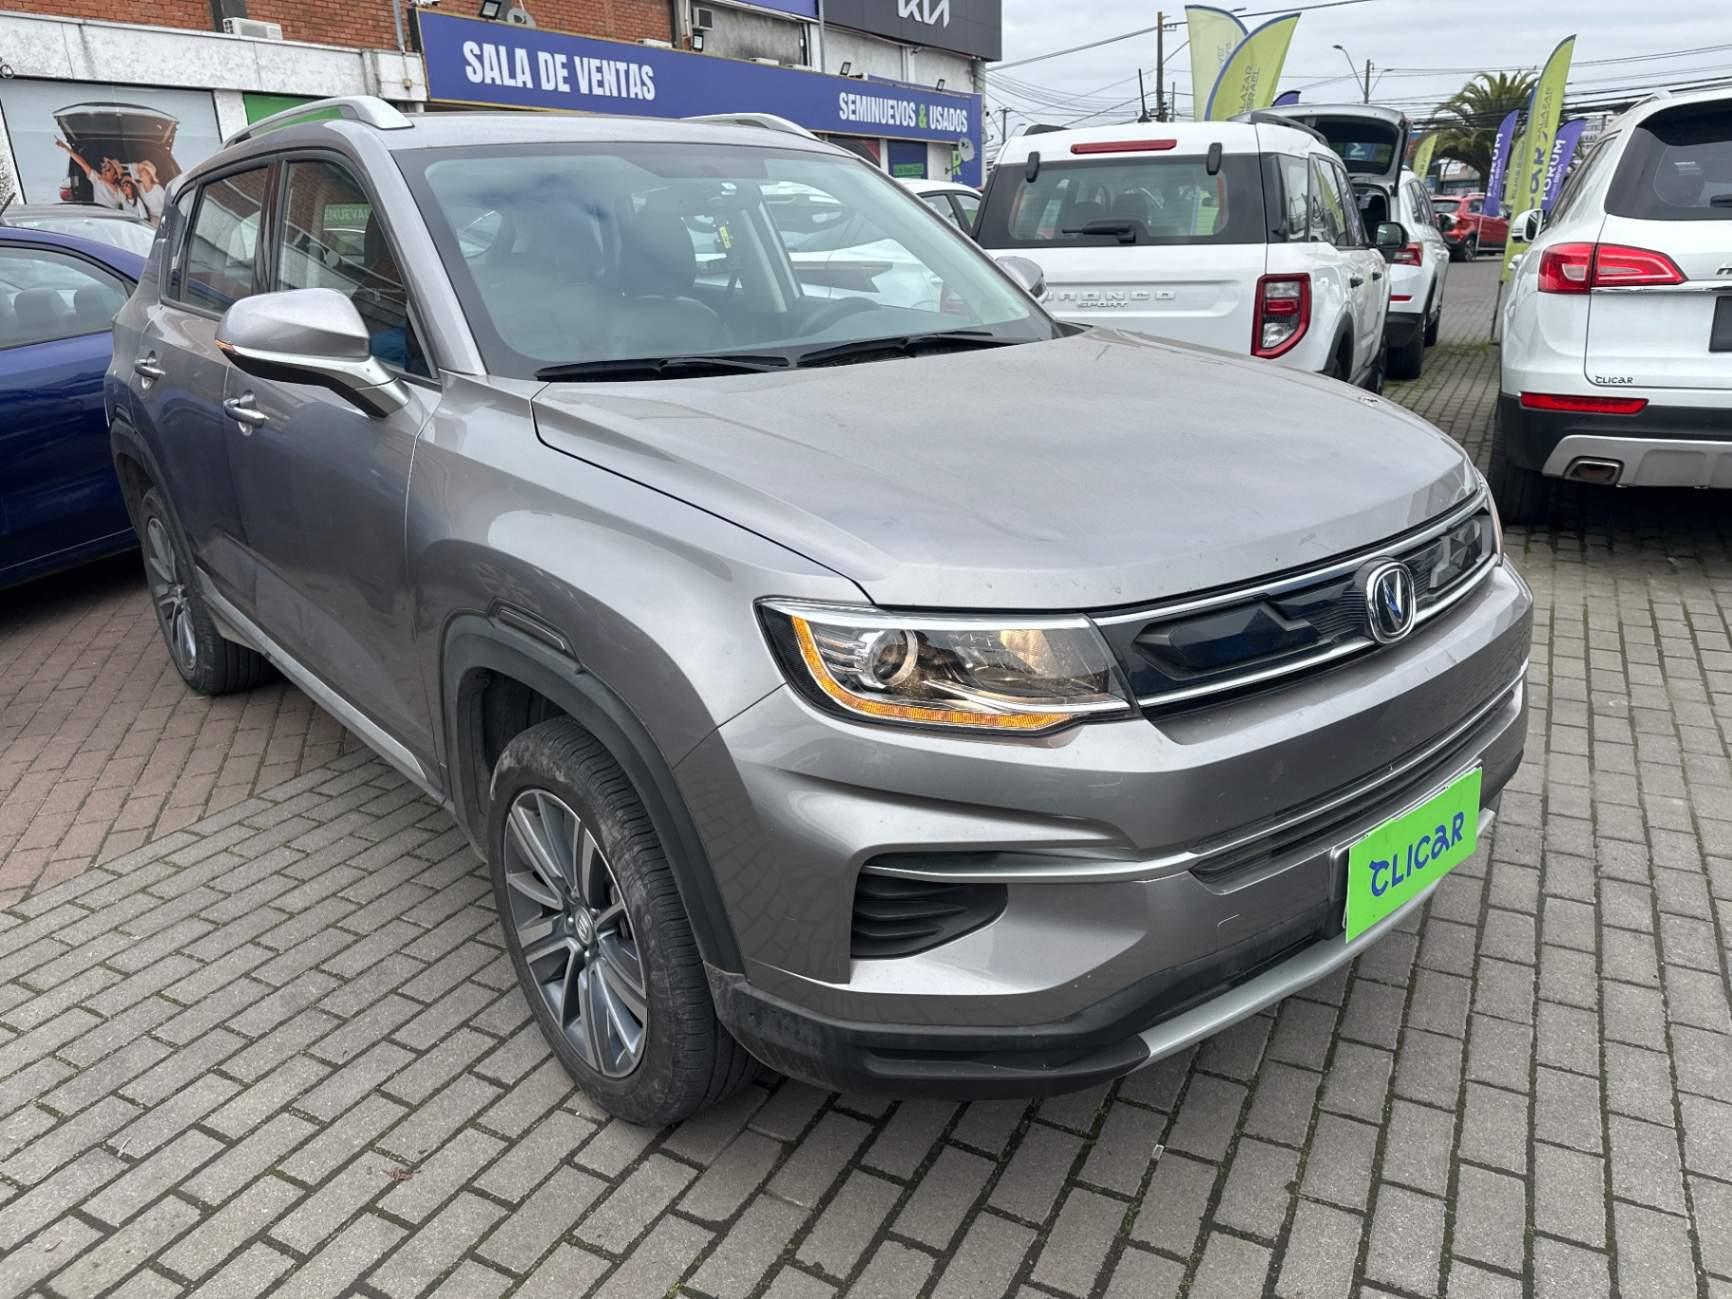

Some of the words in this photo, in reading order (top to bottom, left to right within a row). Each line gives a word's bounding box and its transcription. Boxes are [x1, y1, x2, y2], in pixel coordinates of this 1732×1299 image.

[462, 40, 533, 89] SALA
[537, 50, 571, 93] DE
[573, 55, 656, 101] VENTAS
[839, 91, 916, 128] SEMINUEVOS
[918, 103, 928, 129] &
[929, 104, 968, 133] USADOS
[1541, 139, 1567, 201] FORUM
